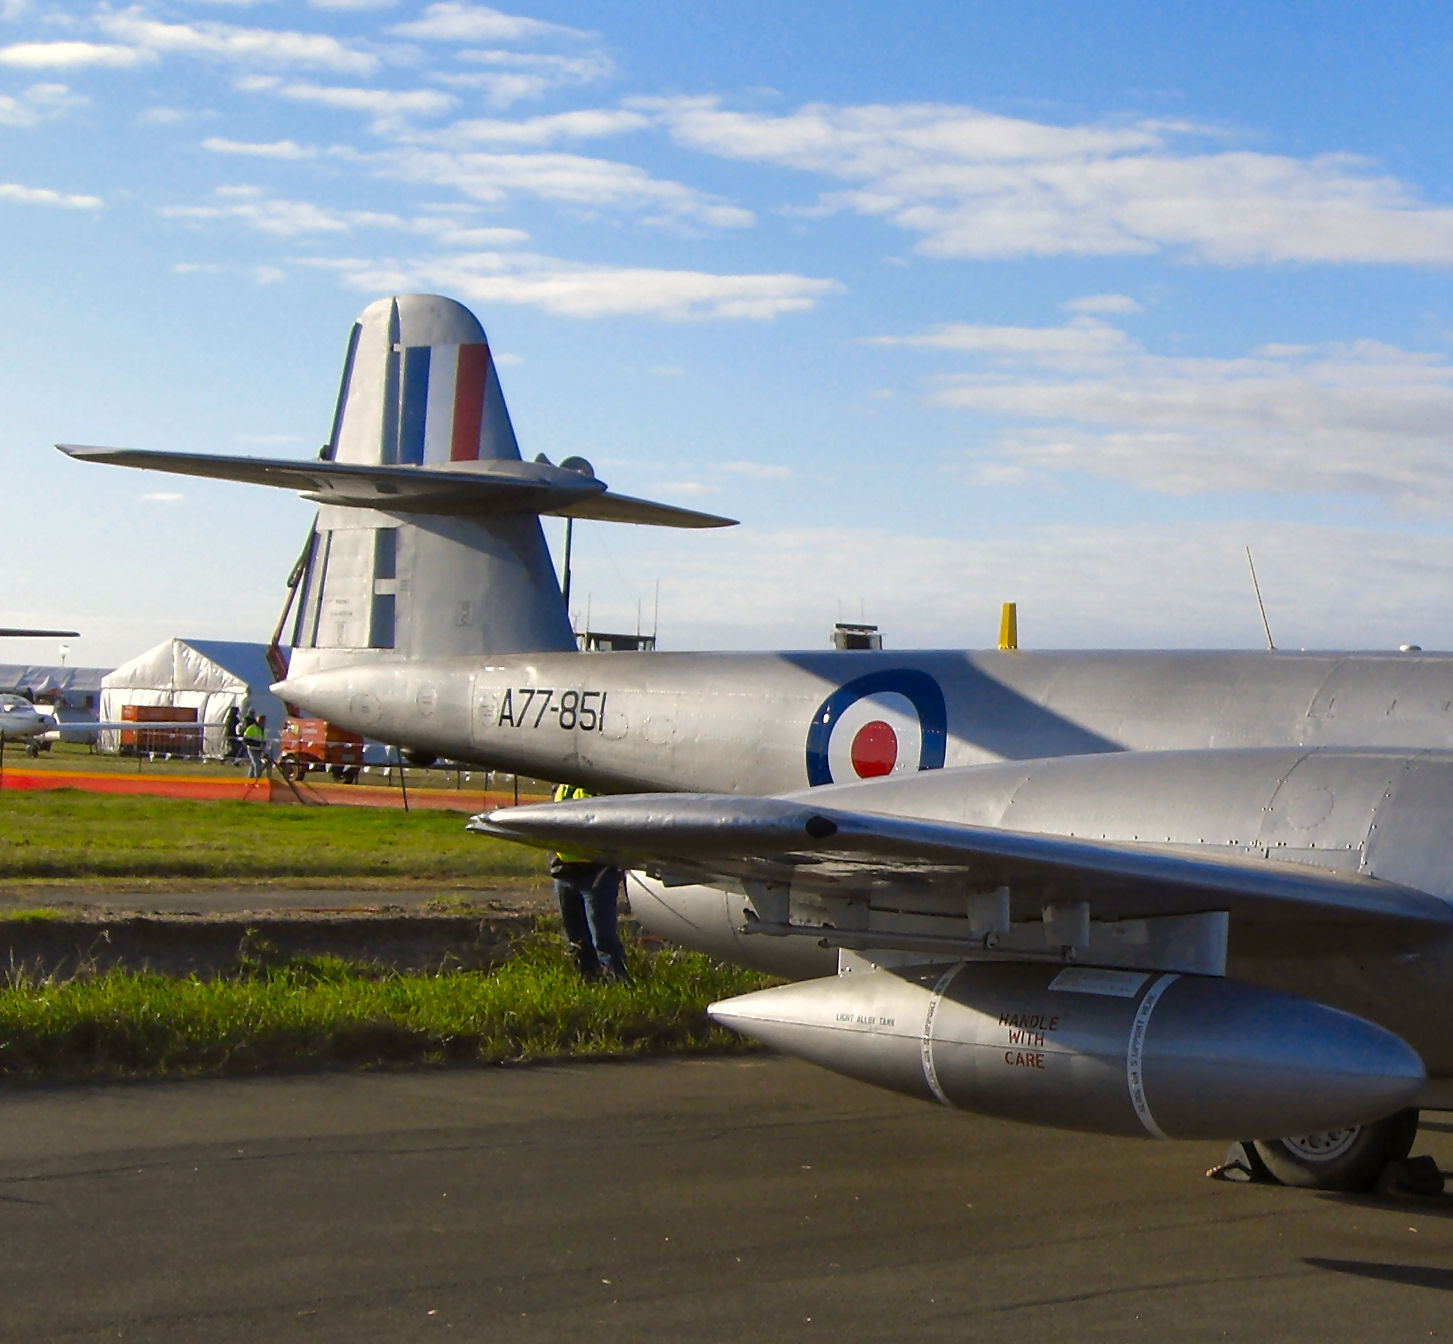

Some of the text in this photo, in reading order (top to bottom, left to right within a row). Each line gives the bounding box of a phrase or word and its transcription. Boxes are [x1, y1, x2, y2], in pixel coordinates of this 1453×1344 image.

[498, 688, 607, 731] A77-851
[999, 1012, 1060, 1032] HANDLE
[1008, 1029, 1045, 1047] WITH
[1004, 1051, 1046, 1070] CARE
